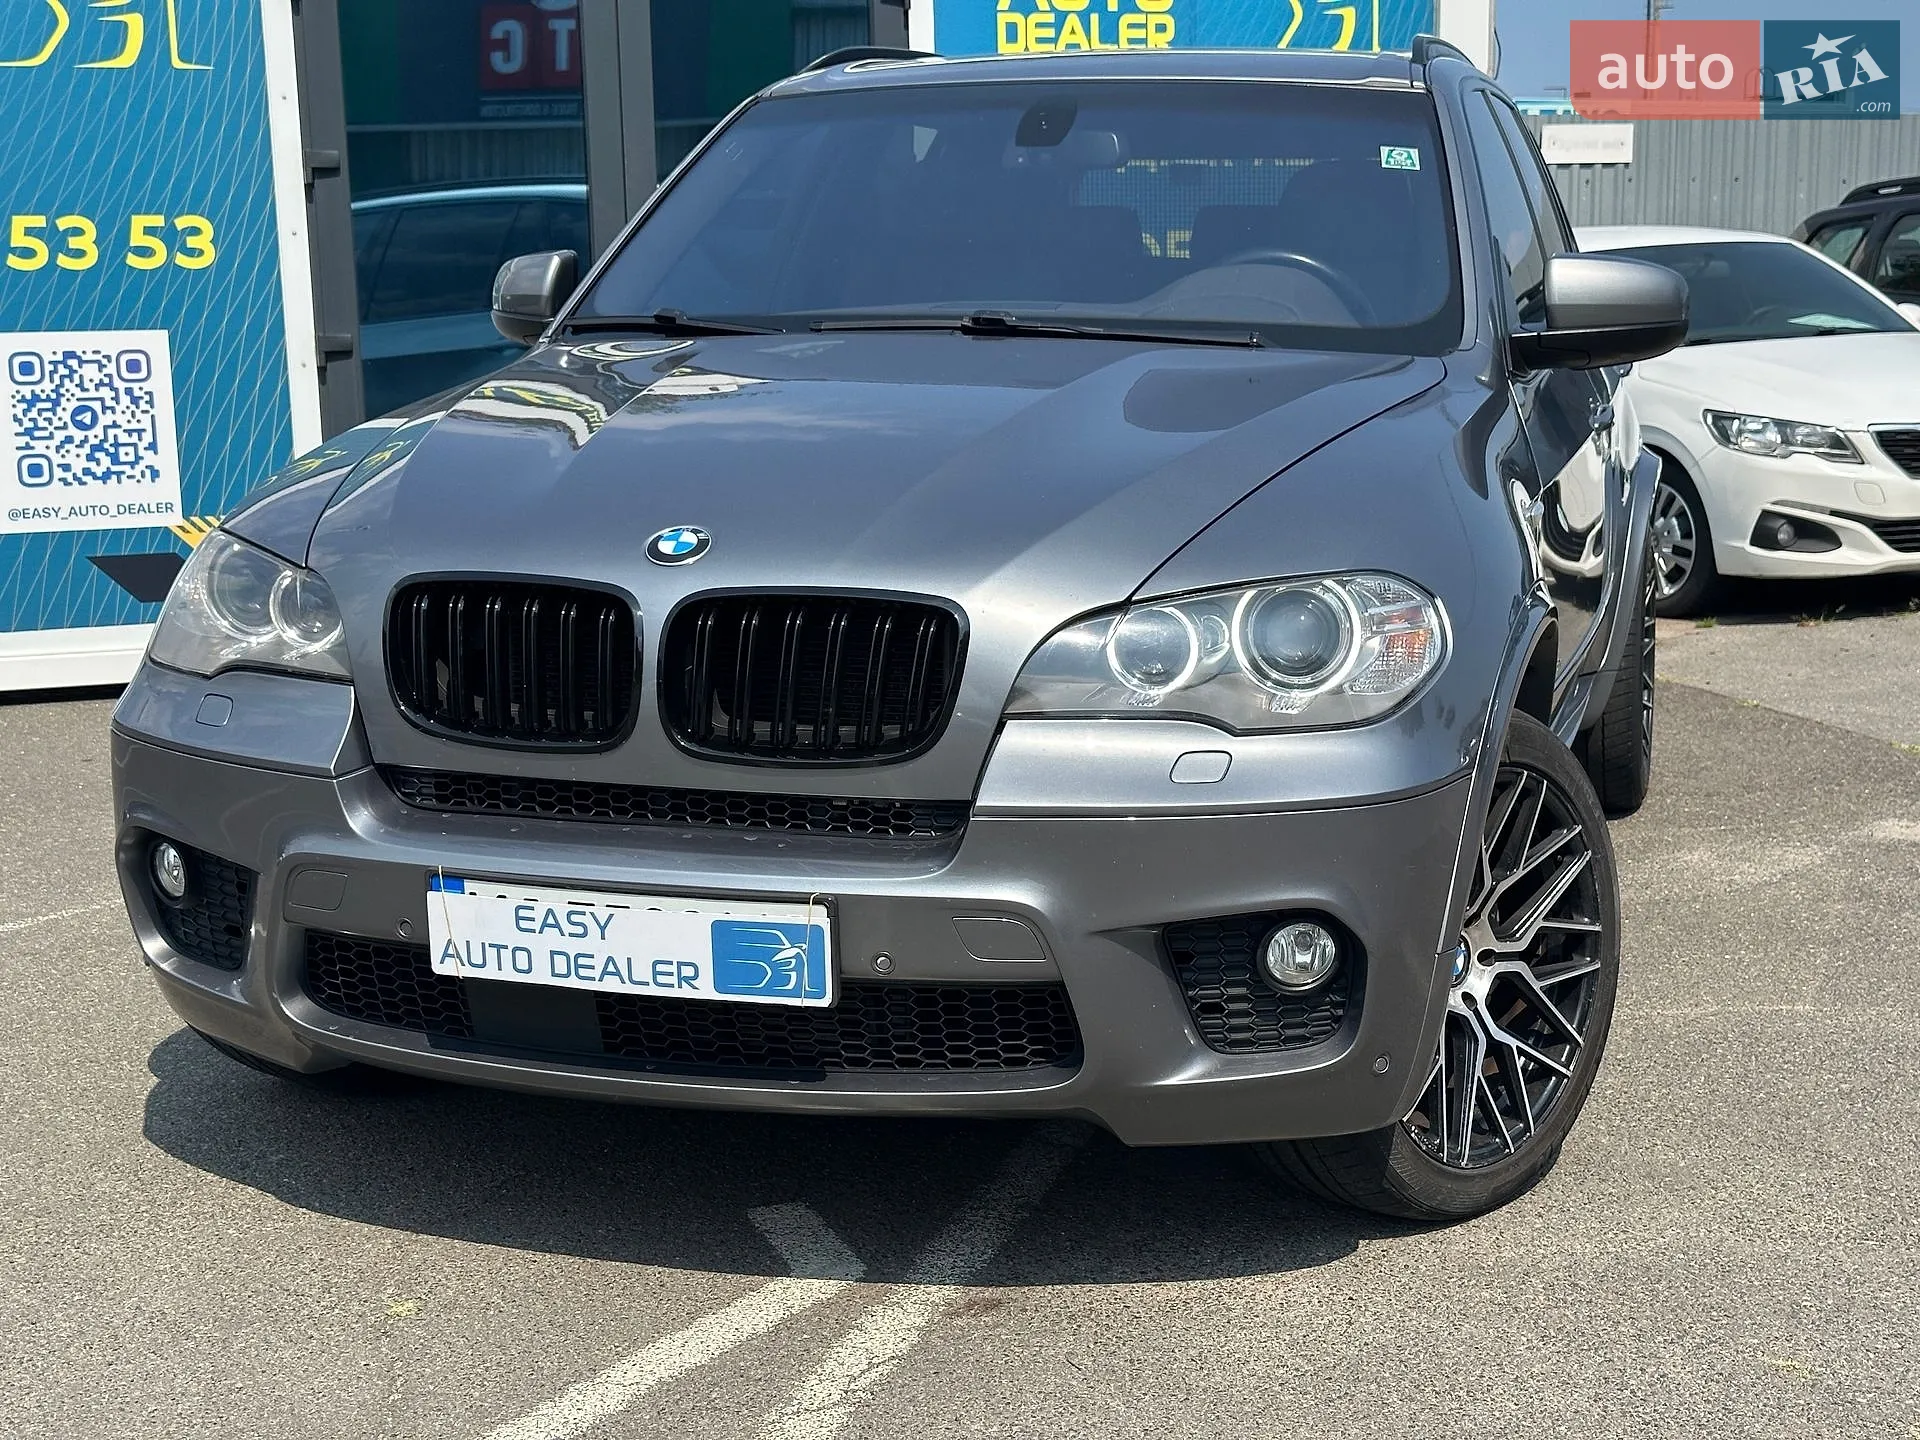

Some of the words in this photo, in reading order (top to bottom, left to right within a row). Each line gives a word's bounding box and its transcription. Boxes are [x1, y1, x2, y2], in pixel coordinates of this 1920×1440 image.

[996, 11, 1176, 56] DEALER
[6, 214, 99, 271] 53
[125, 214, 216, 270] 53
[7, 502, 175, 521] @EASY_AUTO_DEALER
[514, 904, 615, 941] EASY
[439, 938, 533, 975] AUTO
[549, 949, 701, 990] DEALER
